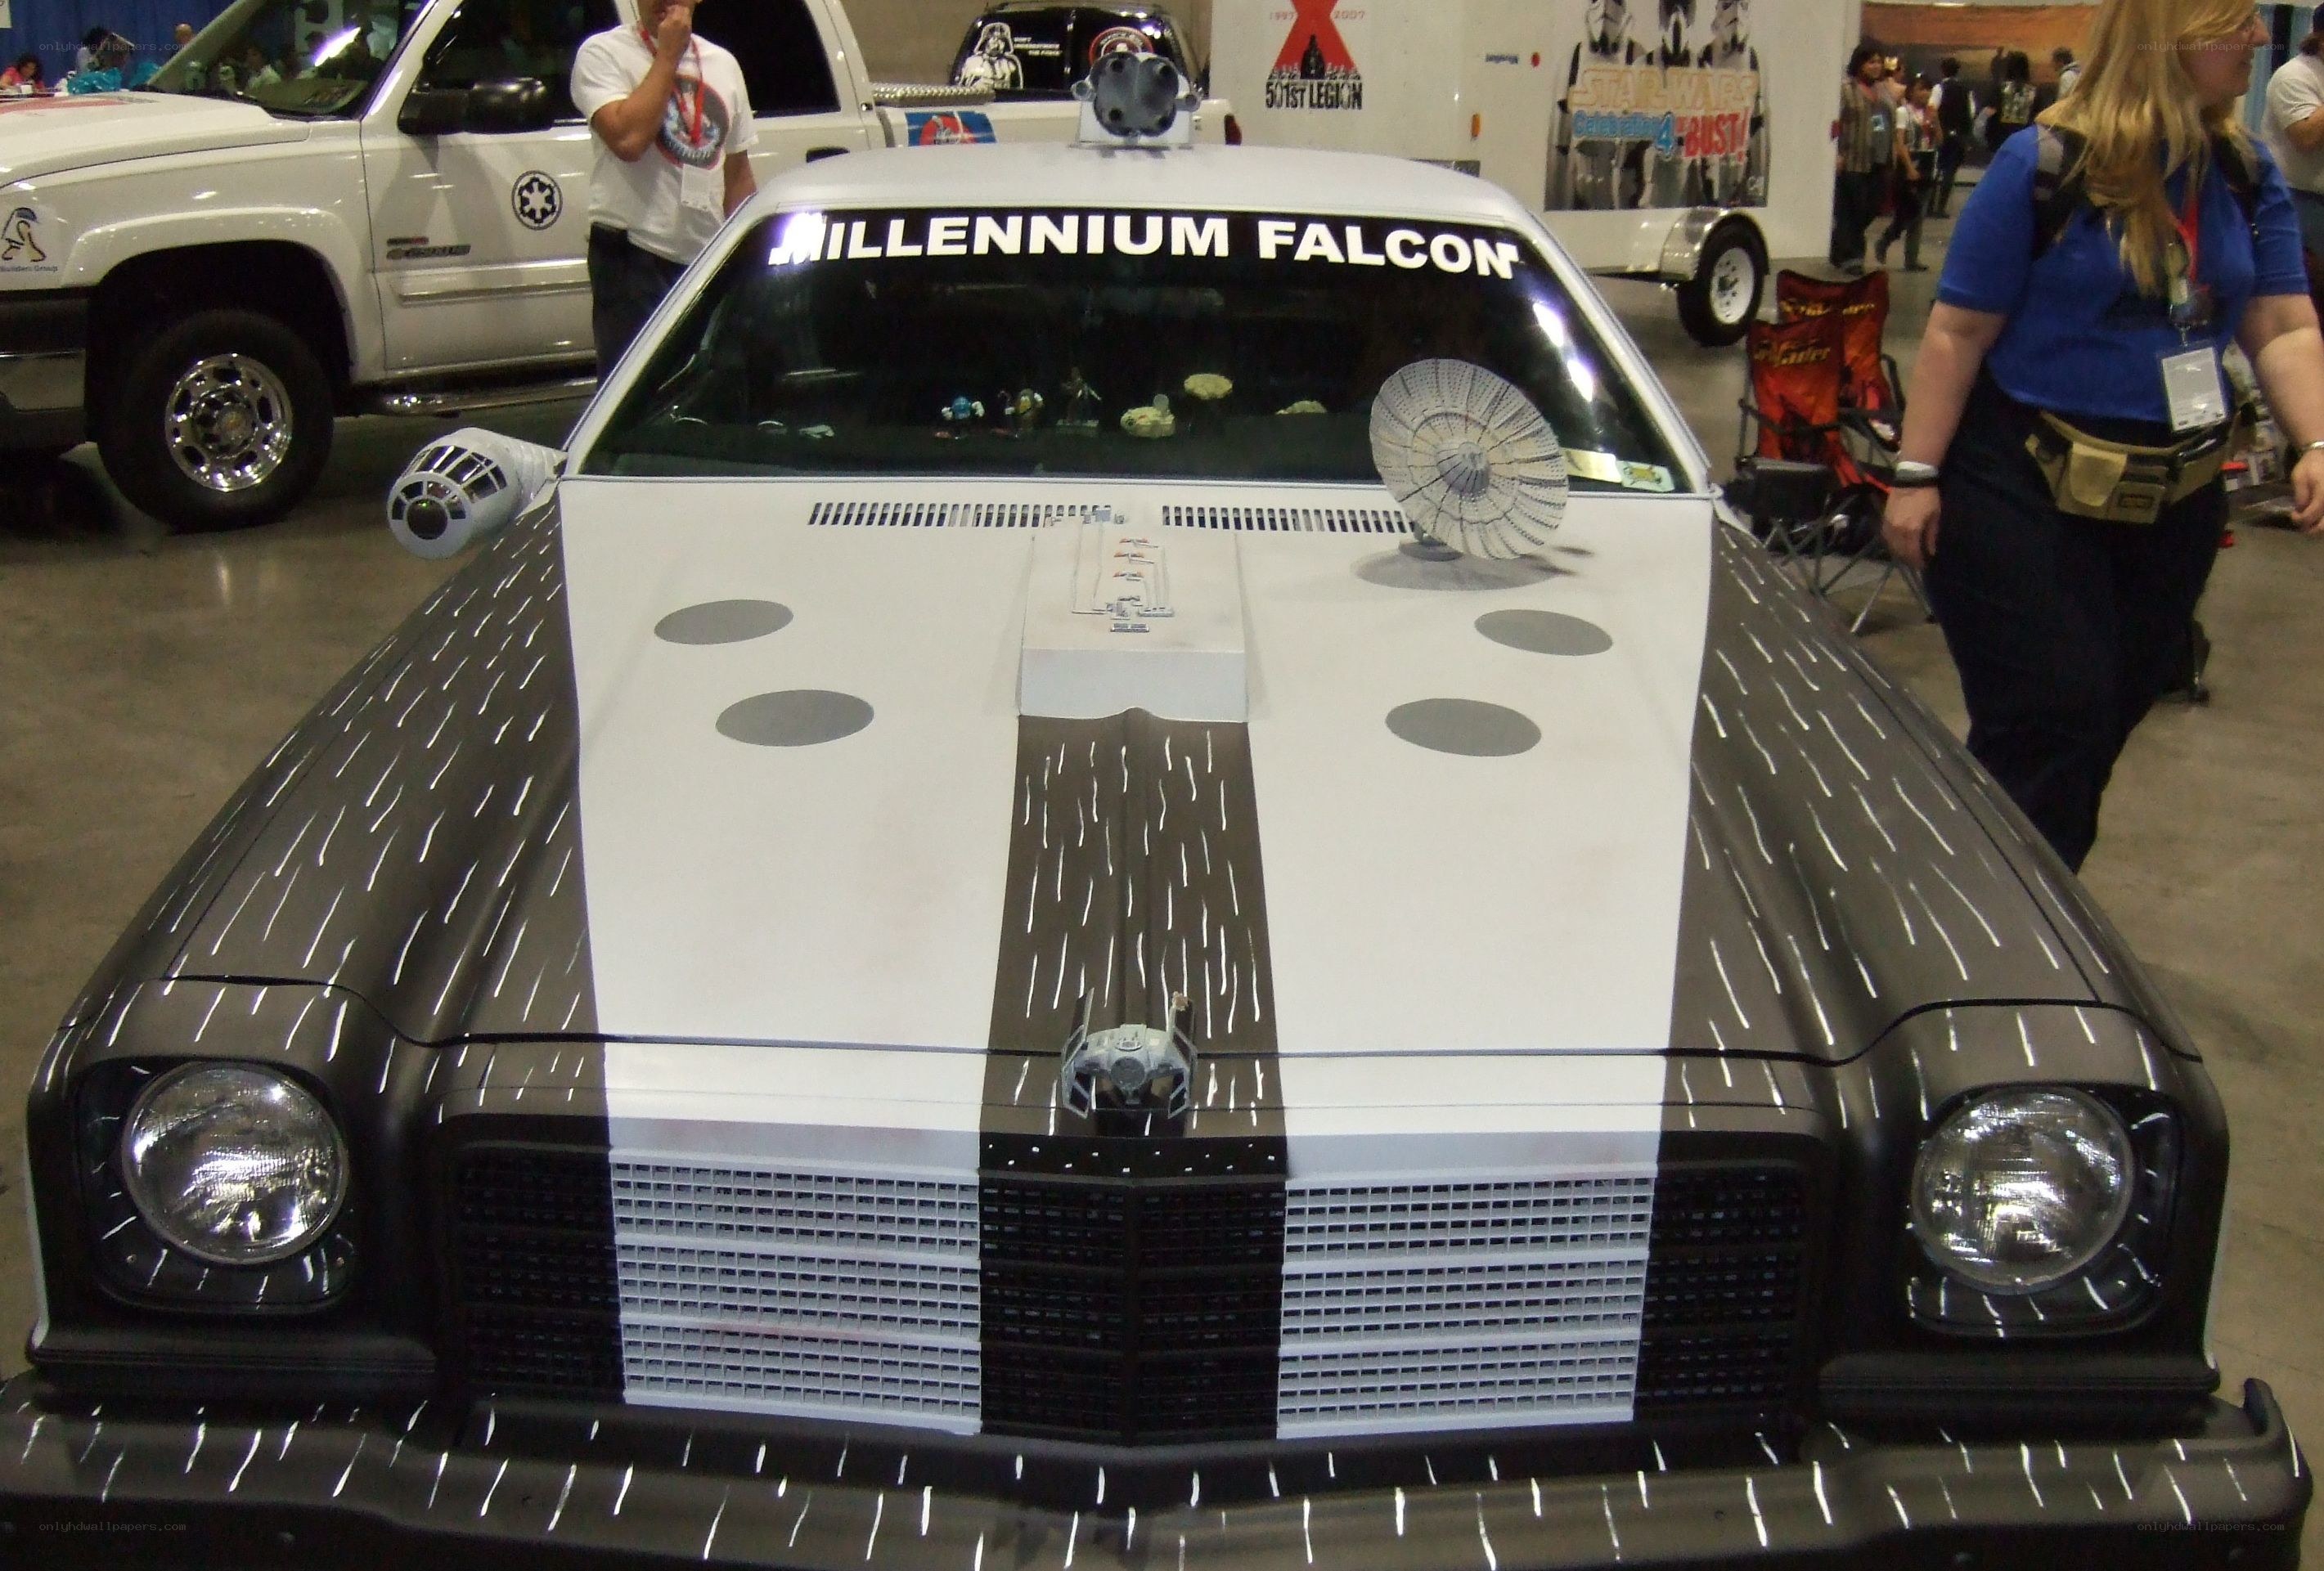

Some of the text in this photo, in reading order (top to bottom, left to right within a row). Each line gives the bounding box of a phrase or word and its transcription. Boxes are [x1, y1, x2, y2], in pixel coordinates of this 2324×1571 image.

[1265, 81, 1363, 110] 501ST LEGION
[1569, 67, 1759, 112] STAR WARS
[767, 211, 1520, 281] MILLENNIUM FALCON
